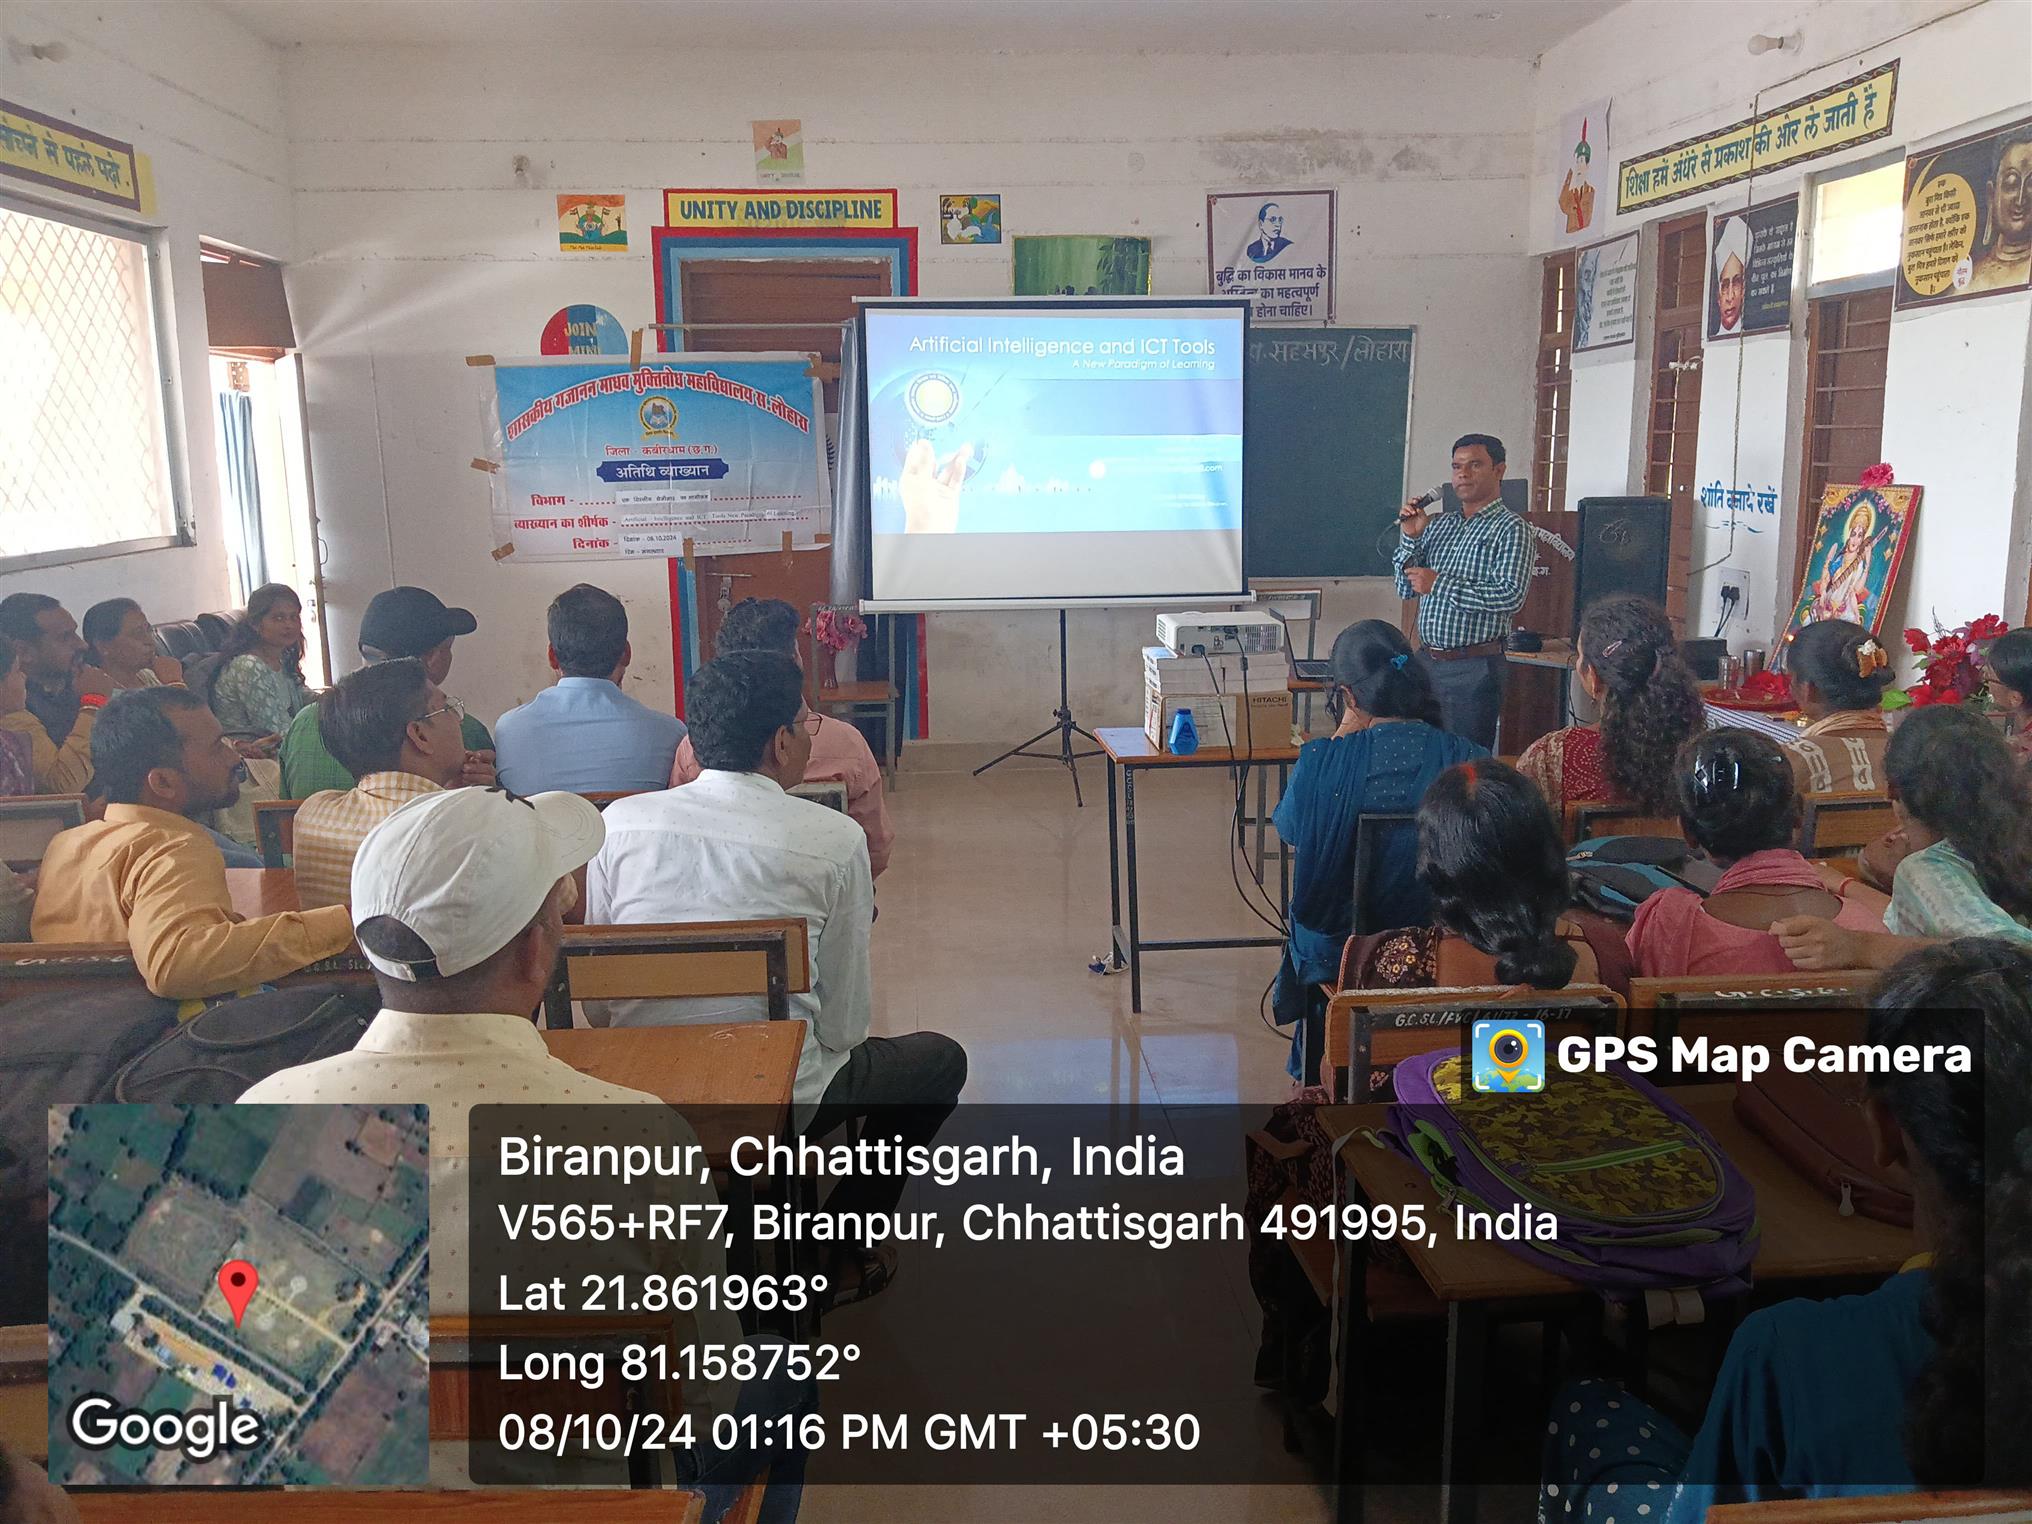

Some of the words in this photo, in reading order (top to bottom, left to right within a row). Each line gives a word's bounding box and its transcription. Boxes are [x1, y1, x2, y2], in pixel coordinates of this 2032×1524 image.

[1626, 165, 1650, 199] शिक्षा
[1652, 158, 1668, 193] हमें
[1700, 144, 1712, 173] से
[1713, 136, 1752, 169] प्रकाश
[1753, 124, 1773, 153] की
[1775, 113, 1801, 144] ओर
[1804, 106, 1820, 139] ले
[1823, 92, 1858, 133] जाती
[680, 200, 738, 220] UNITY
[743, 200, 782, 220] AND
[787, 199, 882, 220] DISCIPLINE
[1216, 266, 1235, 287] बुद्धि
[1237, 270, 1251, 280] का
[1254, 266, 1286, 280] विकास
[1289, 267, 1314, 280] मानव
[1316, 264, 1327, 279] के
[1261, 287, 1274, 299] का
[1276, 283, 1320, 301] महत्वपूर्ण
[1256, 302, 1277, 318] होना
[564, 321, 598, 337] JOIN
[910, 336, 983, 353] Artificial
[988, 336, 1094, 357] Intelligence
[1100, 338, 1135, 354] and
[1141, 339, 1169, 355] ICT
[1172, 339, 1216, 355] Tools
[1072, 359, 1080, 368] A
[1083, 359, 1105, 368] New
[1108, 359, 1157, 371] Paradigm
[1160, 359, 1169, 369] of
[1172, 360, 1215, 370] Learning
[507, 397, 553, 440] शासकीय
[555, 380, 597, 409] गजानन
[599, 373, 631, 393] माधव
[685, 370, 755, 404] महाविद्यालय
[605, 445, 630, 456] जिला
[616, 463, 656, 478] अतिथि
[659, 465, 709, 477] व्याख्यान
[531, 494, 565, 506] विभाग
[1700, 480, 1724, 508] शांति
[1757, 485, 1778, 515] रखें
[514, 519, 557, 529] व्याख्यान
[561, 518, 574, 528] का
[578, 514, 608, 528] शीर्षक
[573, 537, 609, 549] दिनांक
